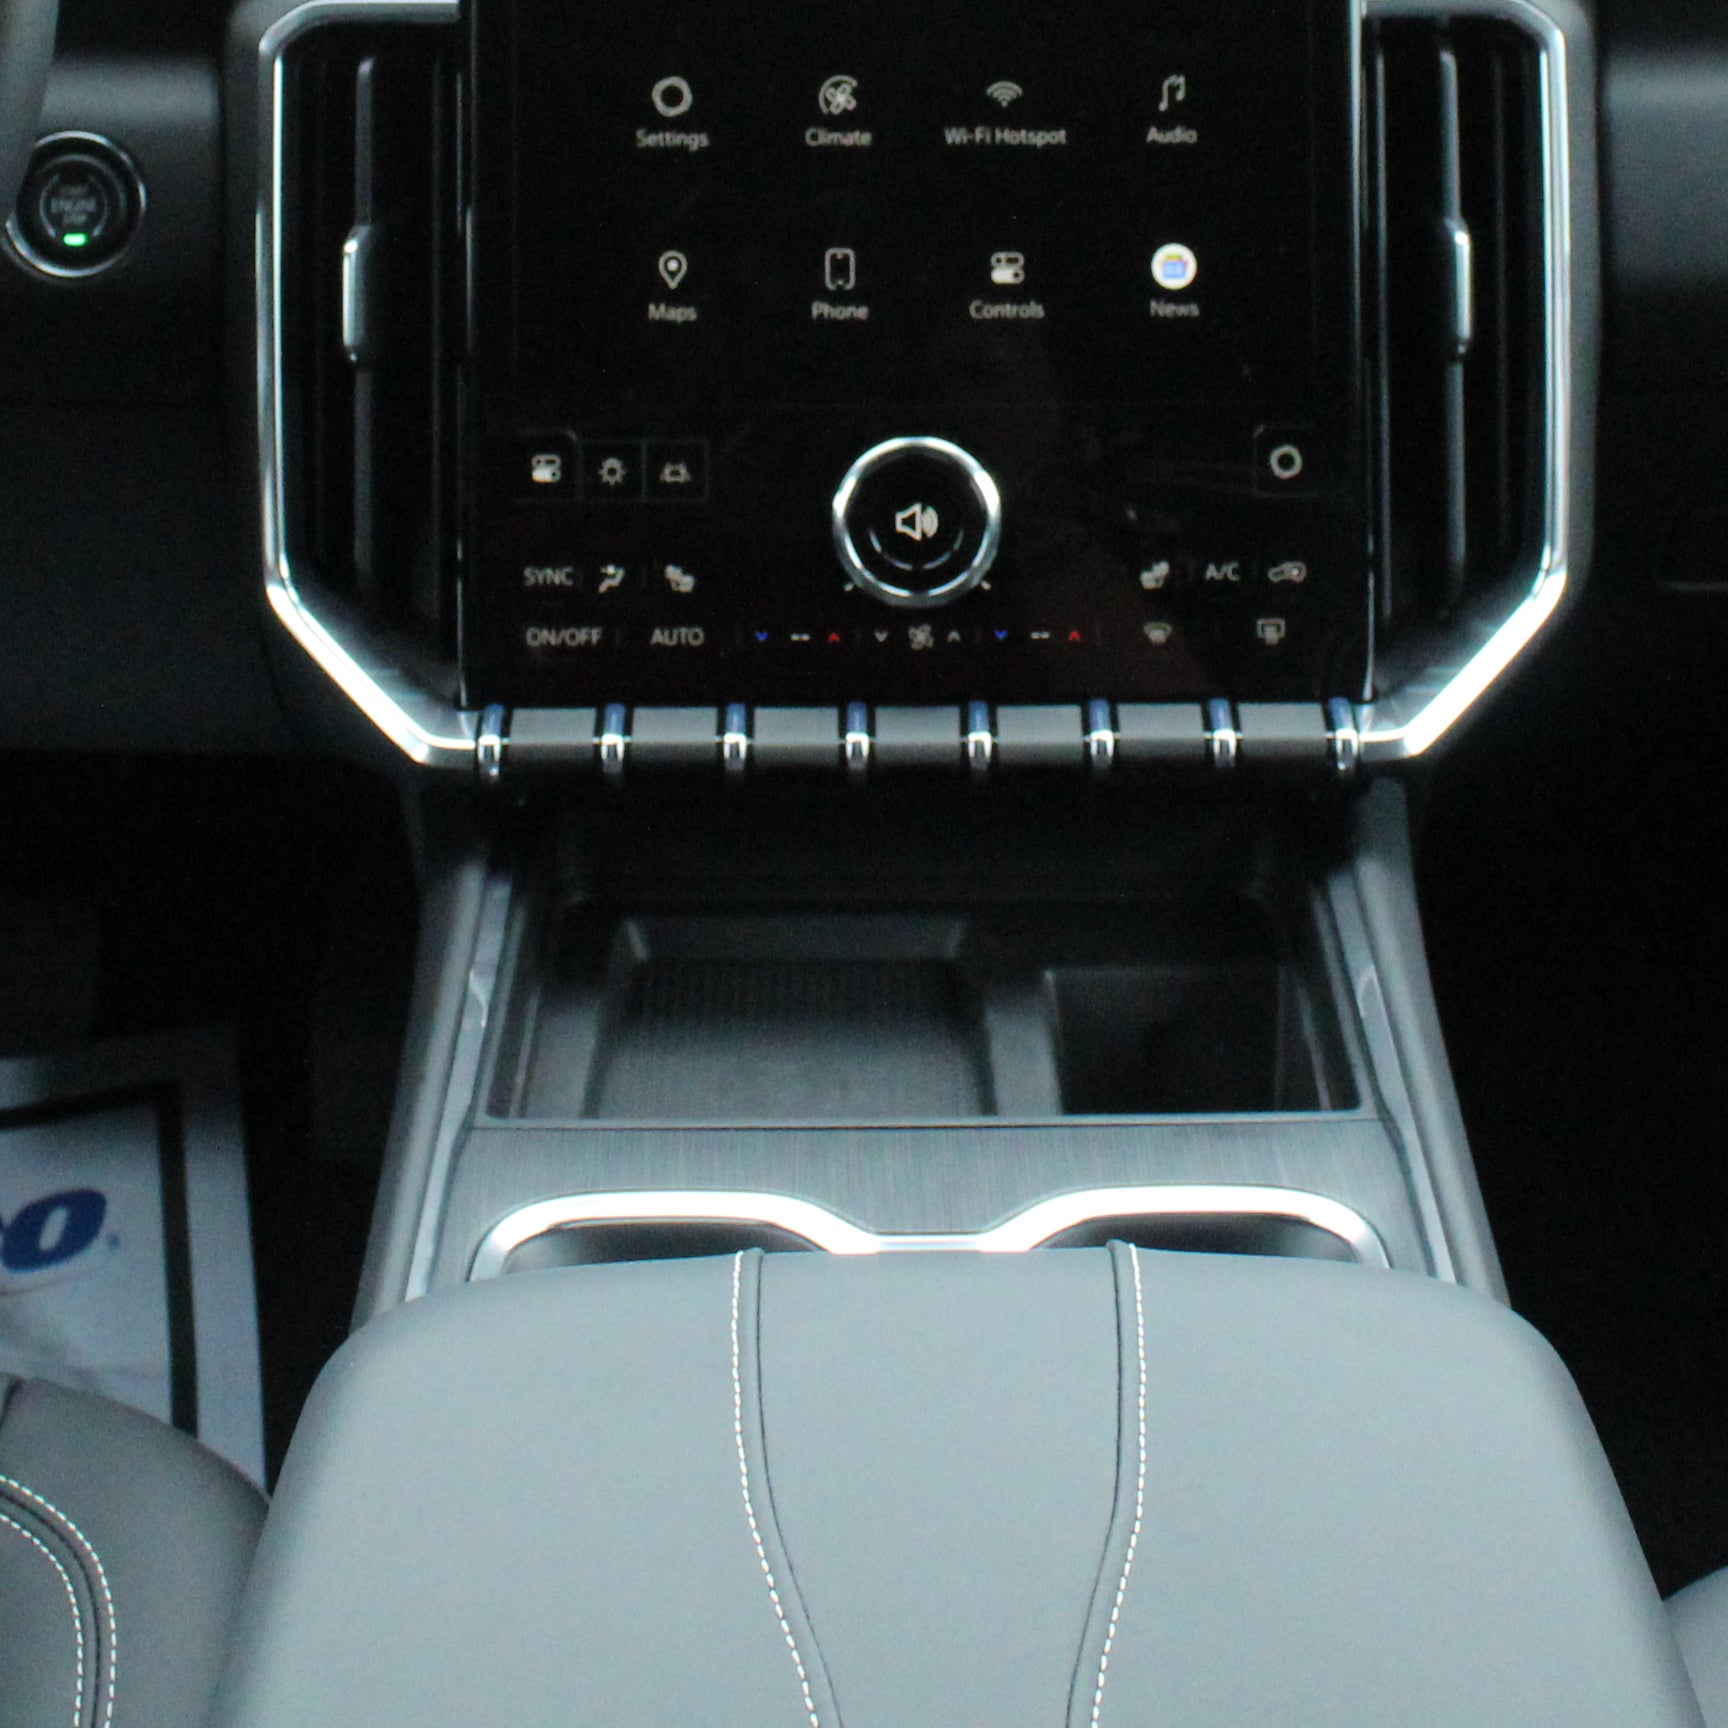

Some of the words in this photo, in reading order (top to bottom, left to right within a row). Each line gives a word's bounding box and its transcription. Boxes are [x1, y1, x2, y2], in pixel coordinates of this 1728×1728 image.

[636, 129, 709, 150] Settings
[805, 128, 872, 147] Climate
[945, 126, 991, 144] Wi-Fi
[995, 128, 1066, 147] Hotspot
[1146, 126, 1197, 144] Audio
[648, 303, 697, 323] Maps
[812, 300, 868, 320] Phone
[969, 300, 1044, 319] Controls
[1150, 299, 1199, 317] News
[524, 567, 572, 585] SYNC
[1205, 562, 1239, 581] A/C
[526, 628, 601, 647] ON/OFF
[651, 627, 704, 646] AUTO
